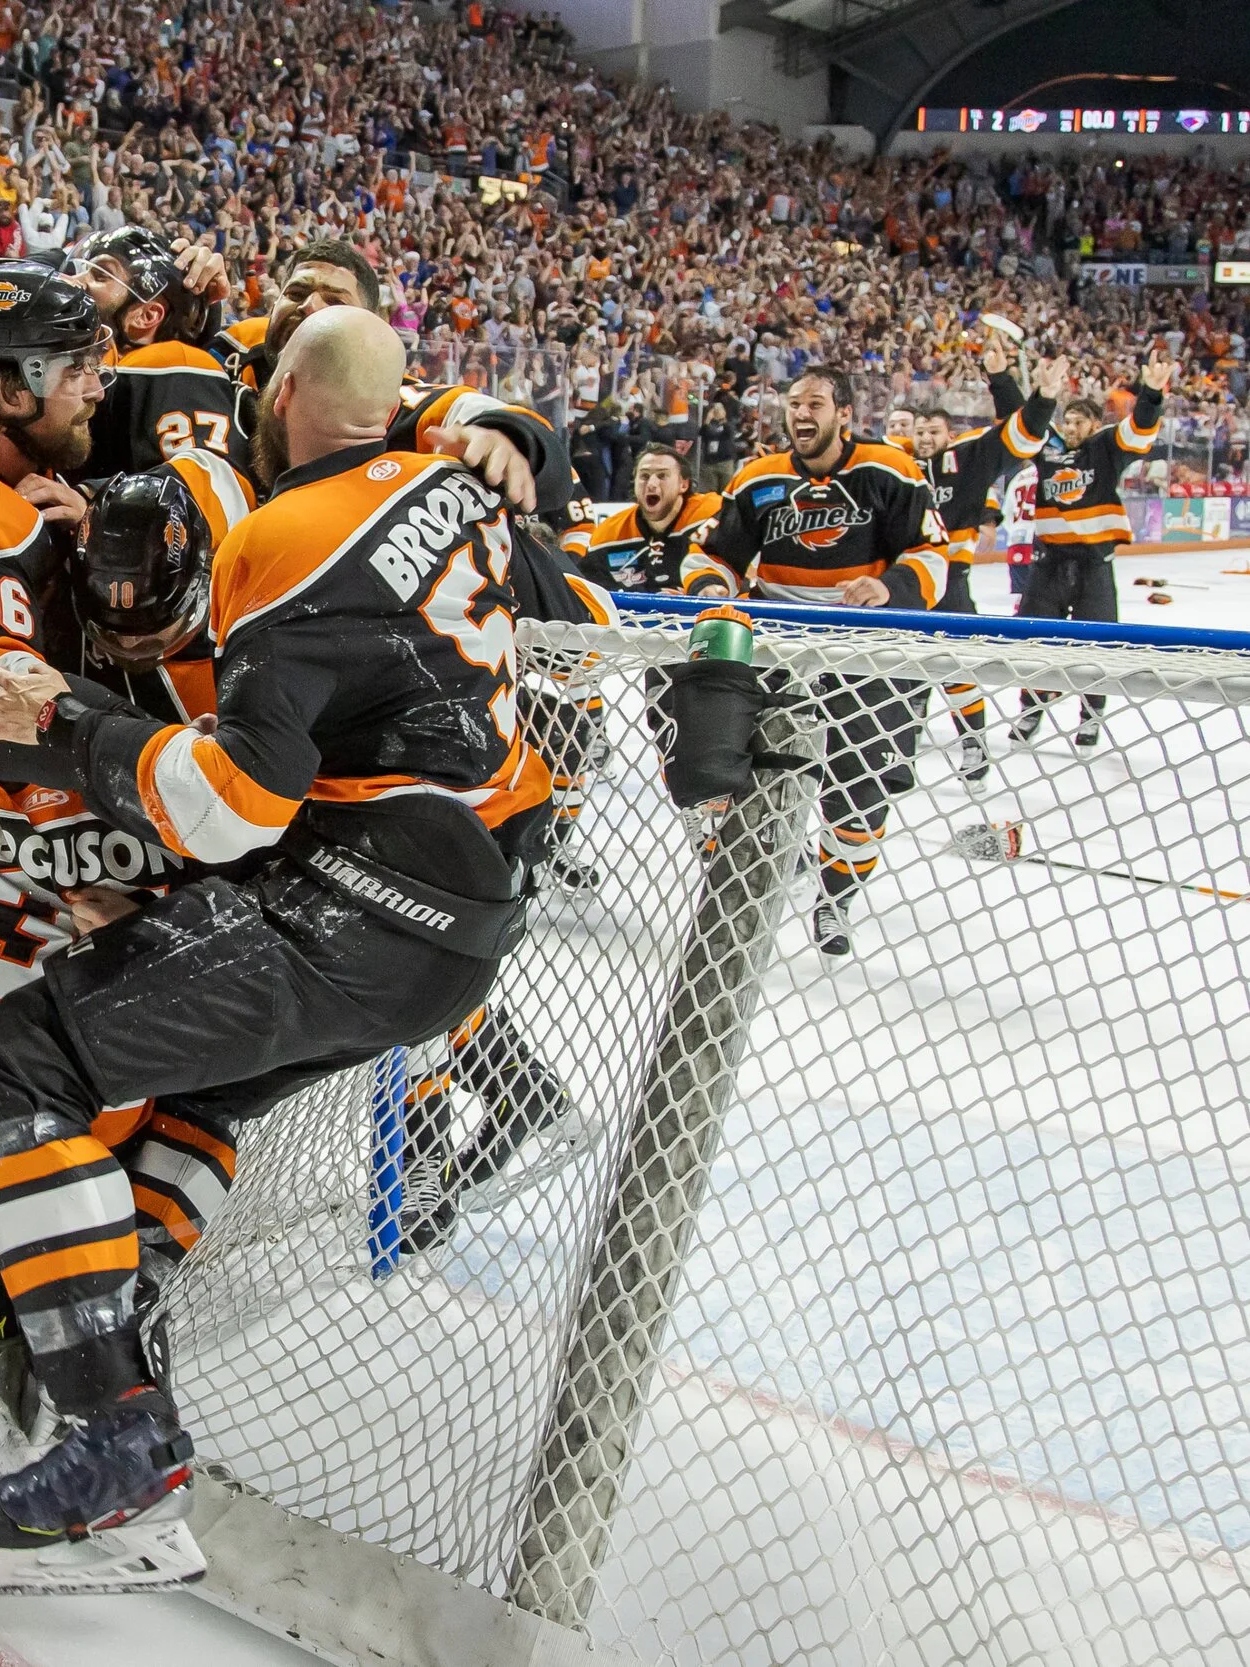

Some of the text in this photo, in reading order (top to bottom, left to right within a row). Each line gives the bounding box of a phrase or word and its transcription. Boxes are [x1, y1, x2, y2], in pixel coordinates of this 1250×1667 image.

[156, 411, 230, 462] 27
[942, 451, 959, 473] A
[763, 506, 873, 545] Komets
[109, 581, 134, 609] 10
[308, 848, 456, 931] WARRIOR
